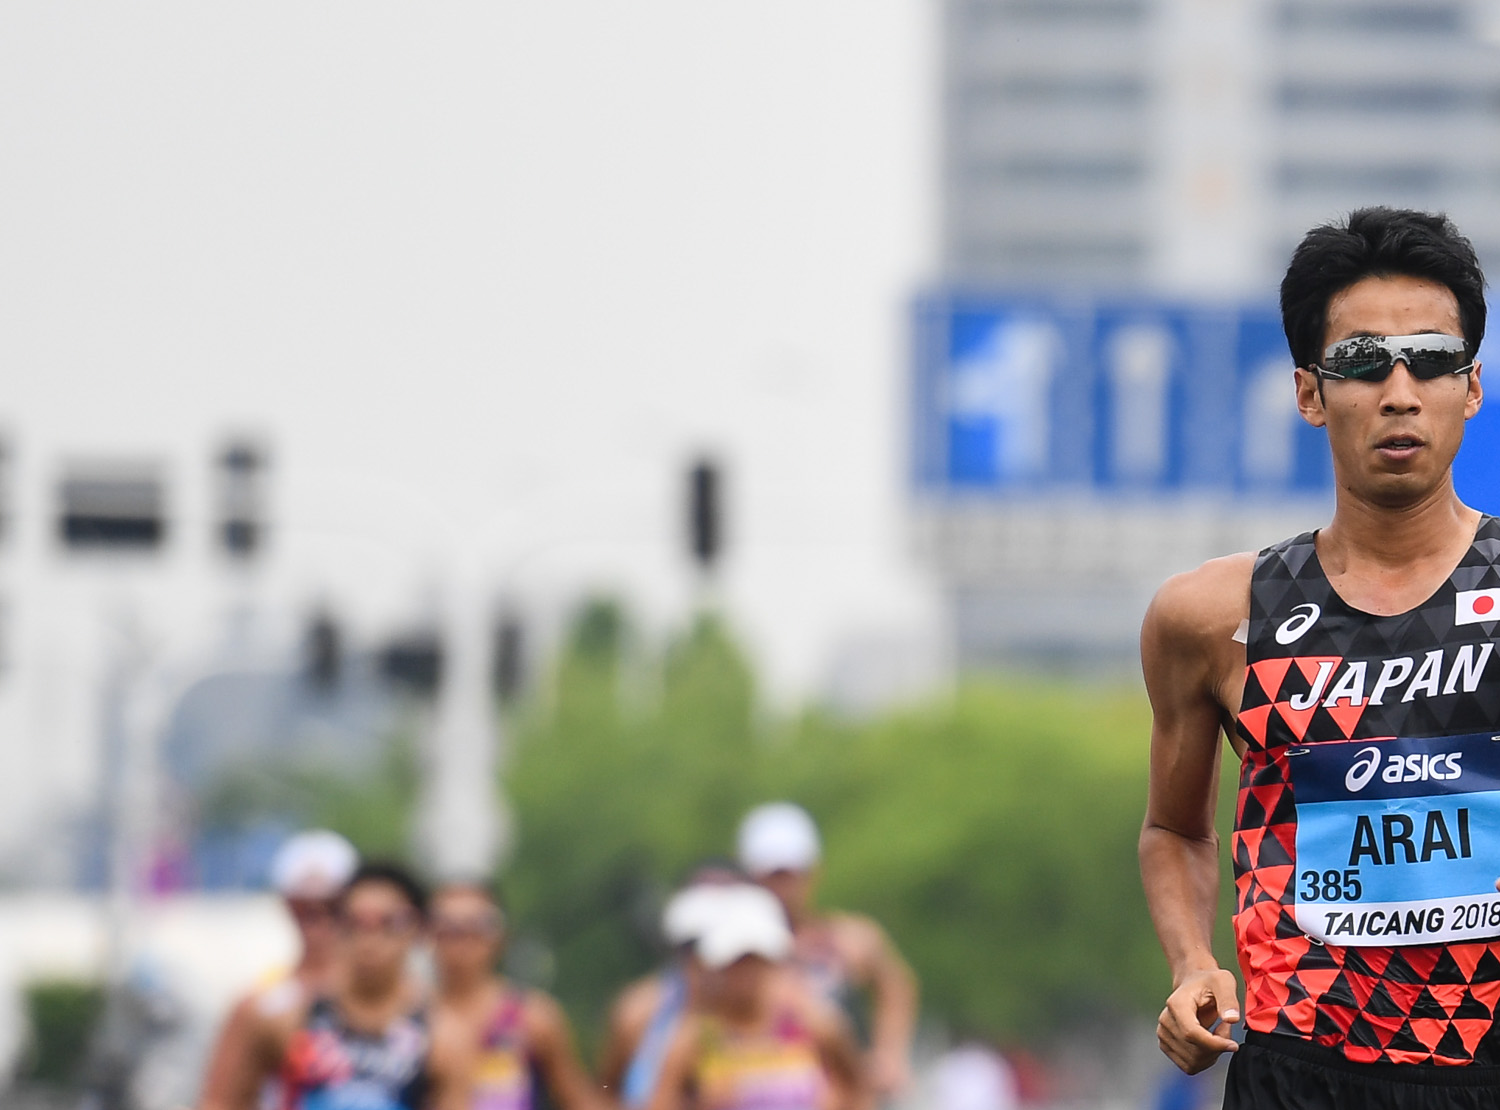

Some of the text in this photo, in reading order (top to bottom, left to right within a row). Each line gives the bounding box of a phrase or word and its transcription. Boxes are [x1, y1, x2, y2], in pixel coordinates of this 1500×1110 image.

[1289, 642, 1496, 711] JAPAN
[1381, 751, 1463, 783] asics
[1347, 807, 1472, 867] ARAI
[1299, 868, 1363, 902] 385
[1323, 907, 1445, 937] TAICANG
